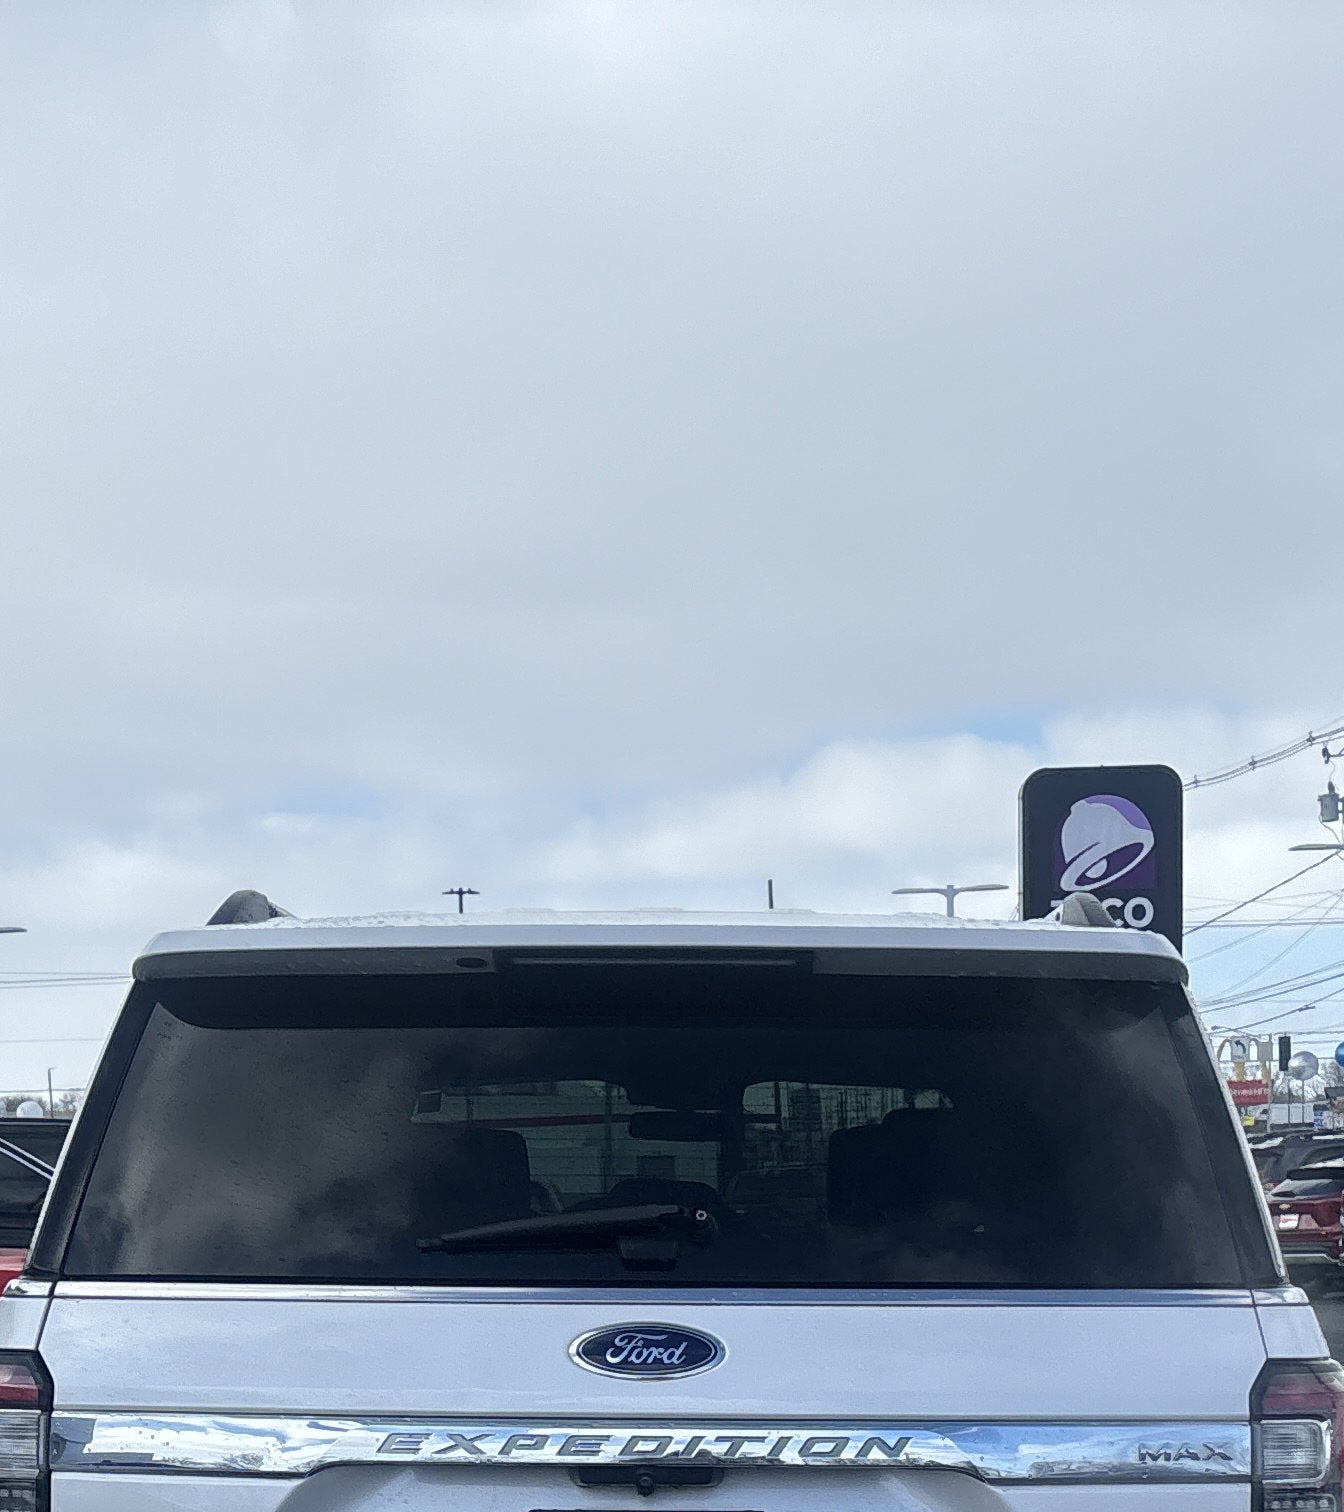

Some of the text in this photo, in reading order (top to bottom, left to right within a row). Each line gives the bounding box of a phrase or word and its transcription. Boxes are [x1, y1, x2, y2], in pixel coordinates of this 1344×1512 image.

[606, 1332, 688, 1364] Ford
[375, 1431, 915, 1459] EXPEDITION
[1138, 1442, 1233, 1461] MAX
